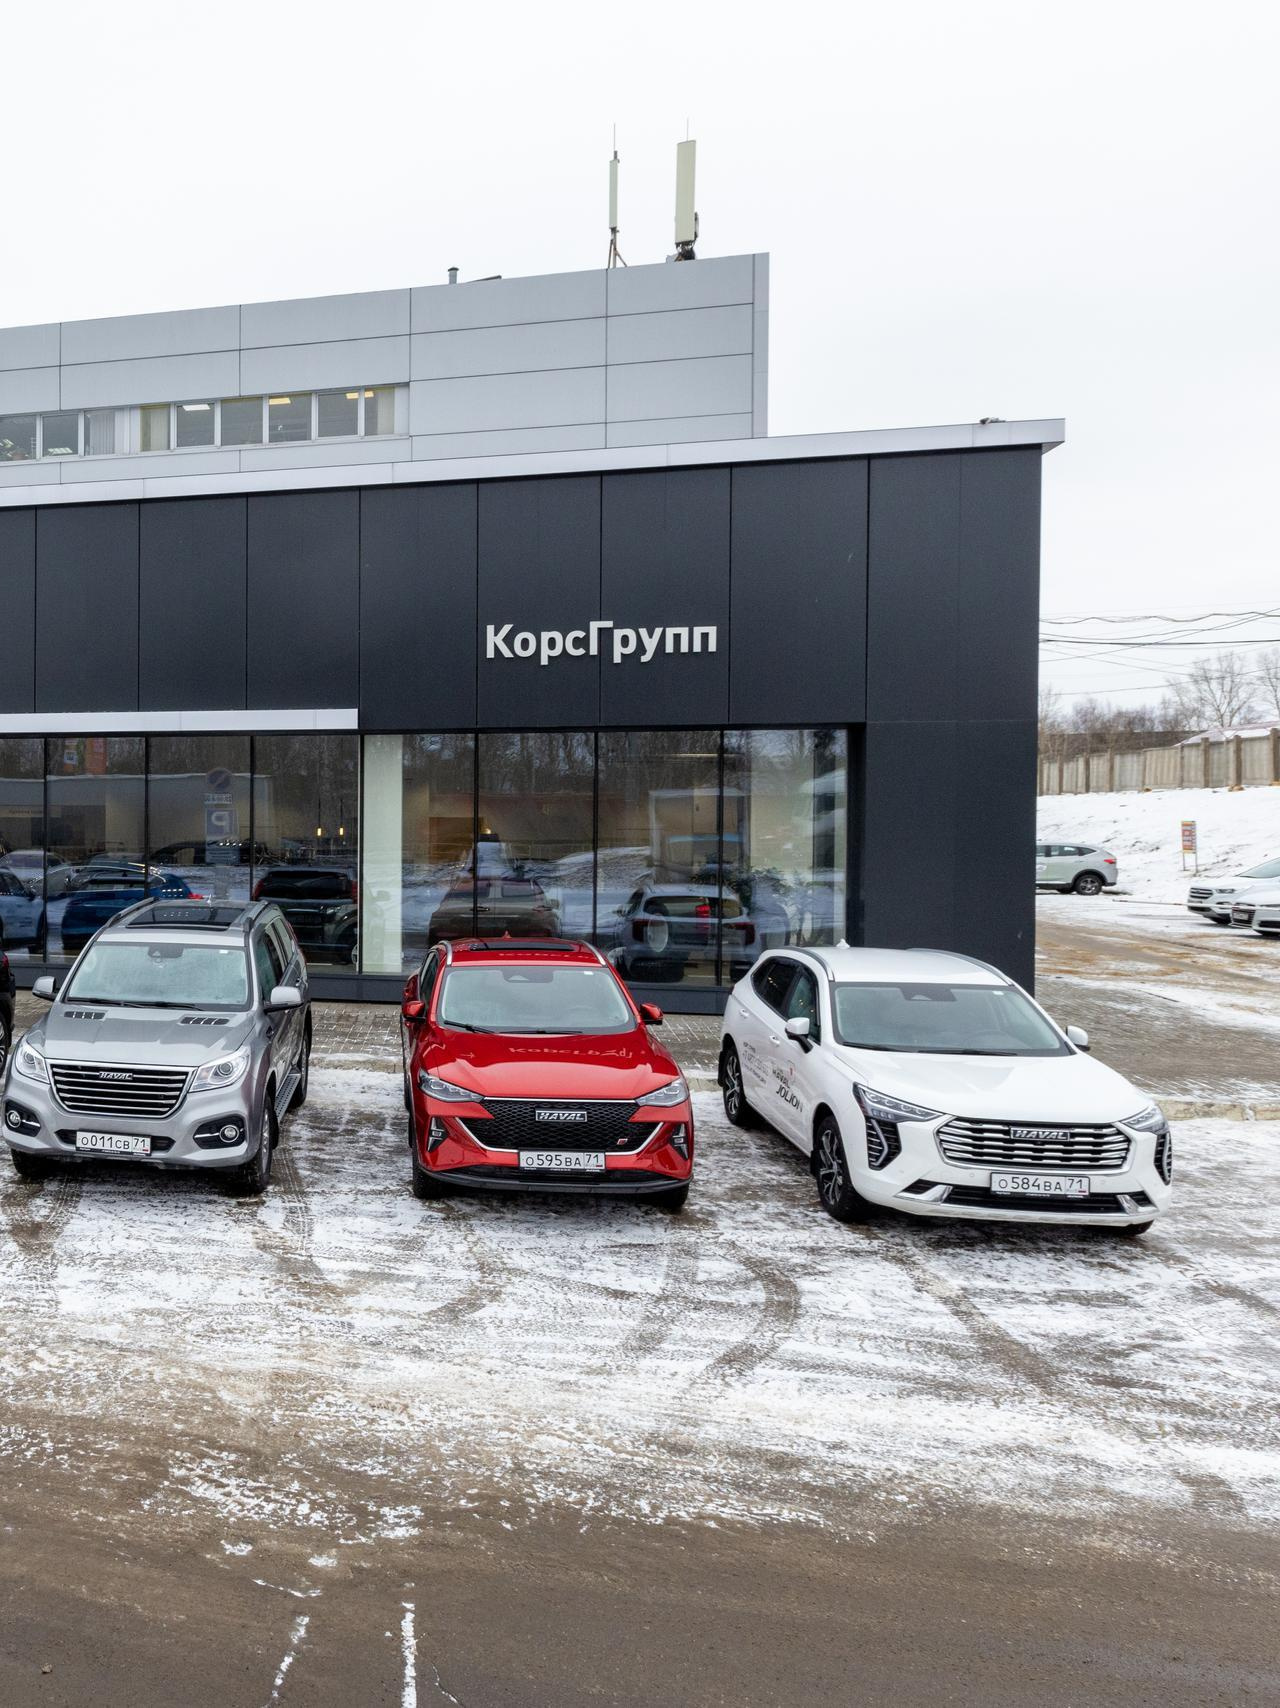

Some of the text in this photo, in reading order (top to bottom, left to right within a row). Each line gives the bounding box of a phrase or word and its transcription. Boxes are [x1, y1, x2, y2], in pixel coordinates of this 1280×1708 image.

[486, 620, 717, 665] КорсГрупп
[540, 1112, 584, 1120] HAVAL
[1015, 1130, 1067, 1139] HAVAL
